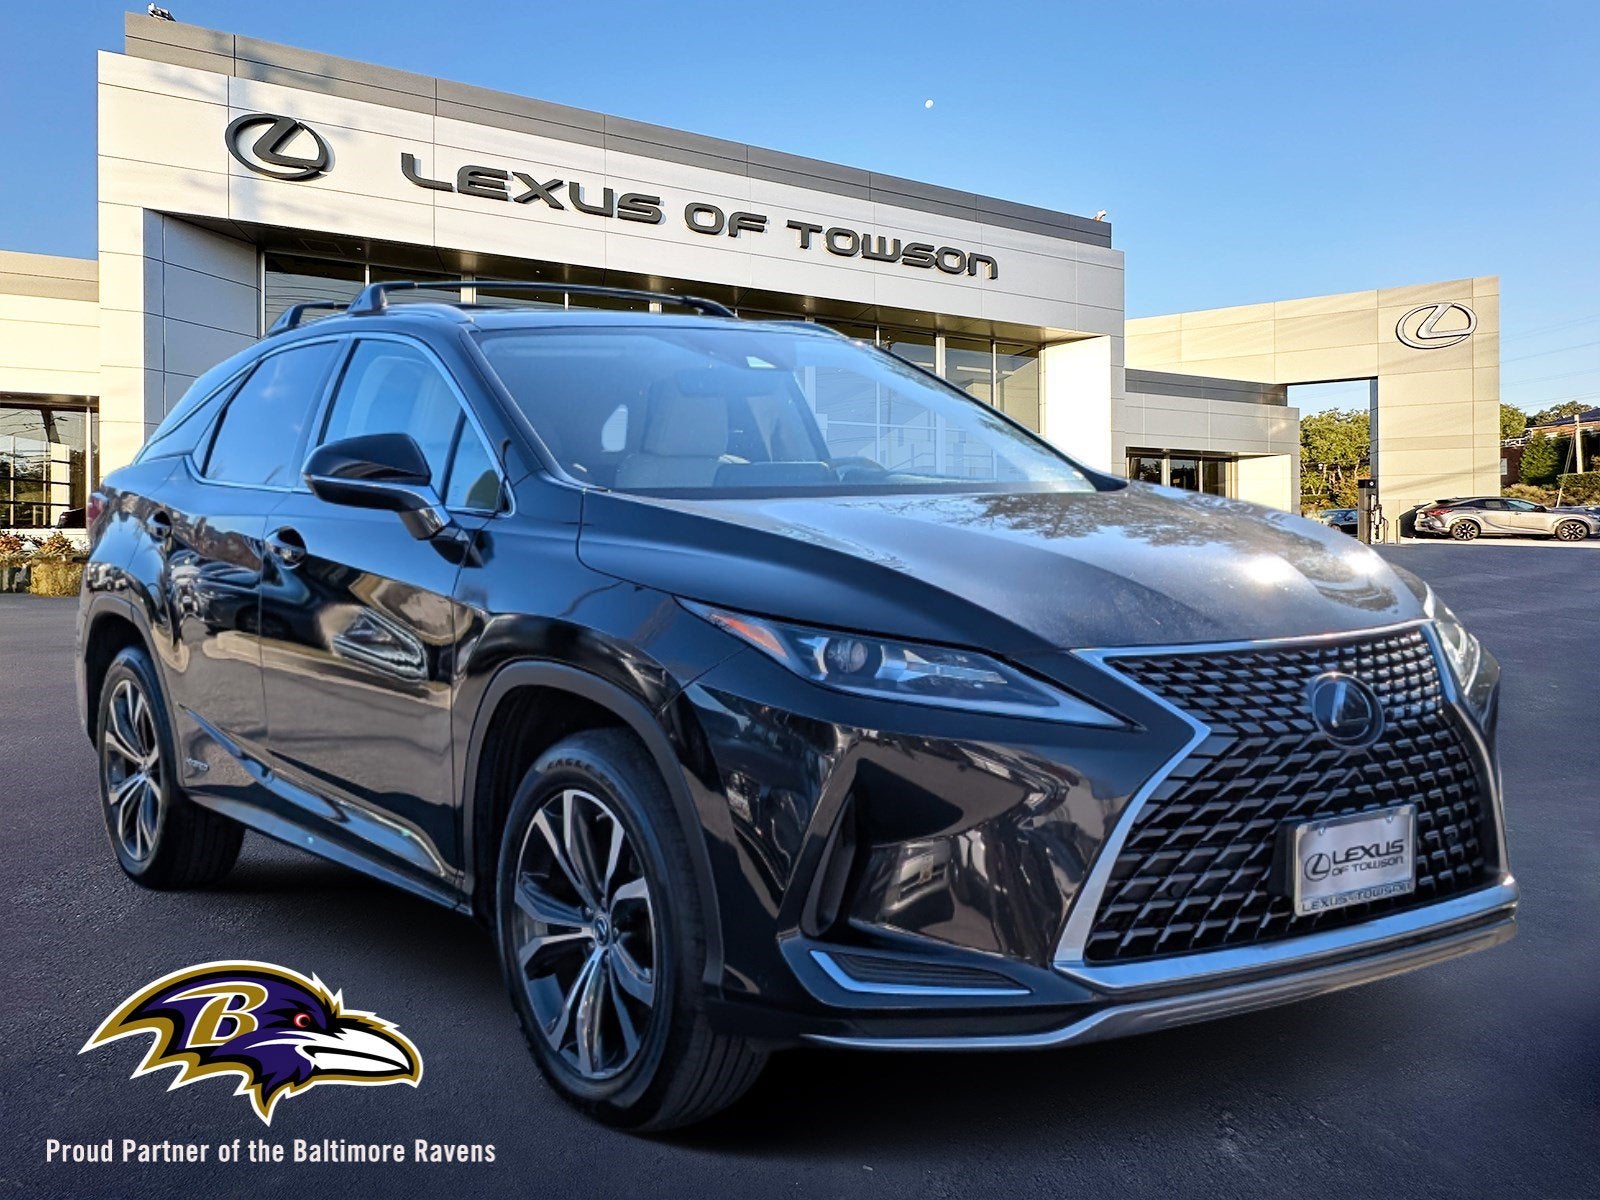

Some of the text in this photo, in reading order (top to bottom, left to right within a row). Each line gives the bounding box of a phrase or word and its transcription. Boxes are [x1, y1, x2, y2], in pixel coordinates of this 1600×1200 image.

[401, 152, 999, 280] LEXUS OF TOWSON
[1333, 839, 1404, 865] LEXUS
[1332, 855, 1404, 876] OF TOWSON
[1302, 896, 1348, 912] LEXUS
